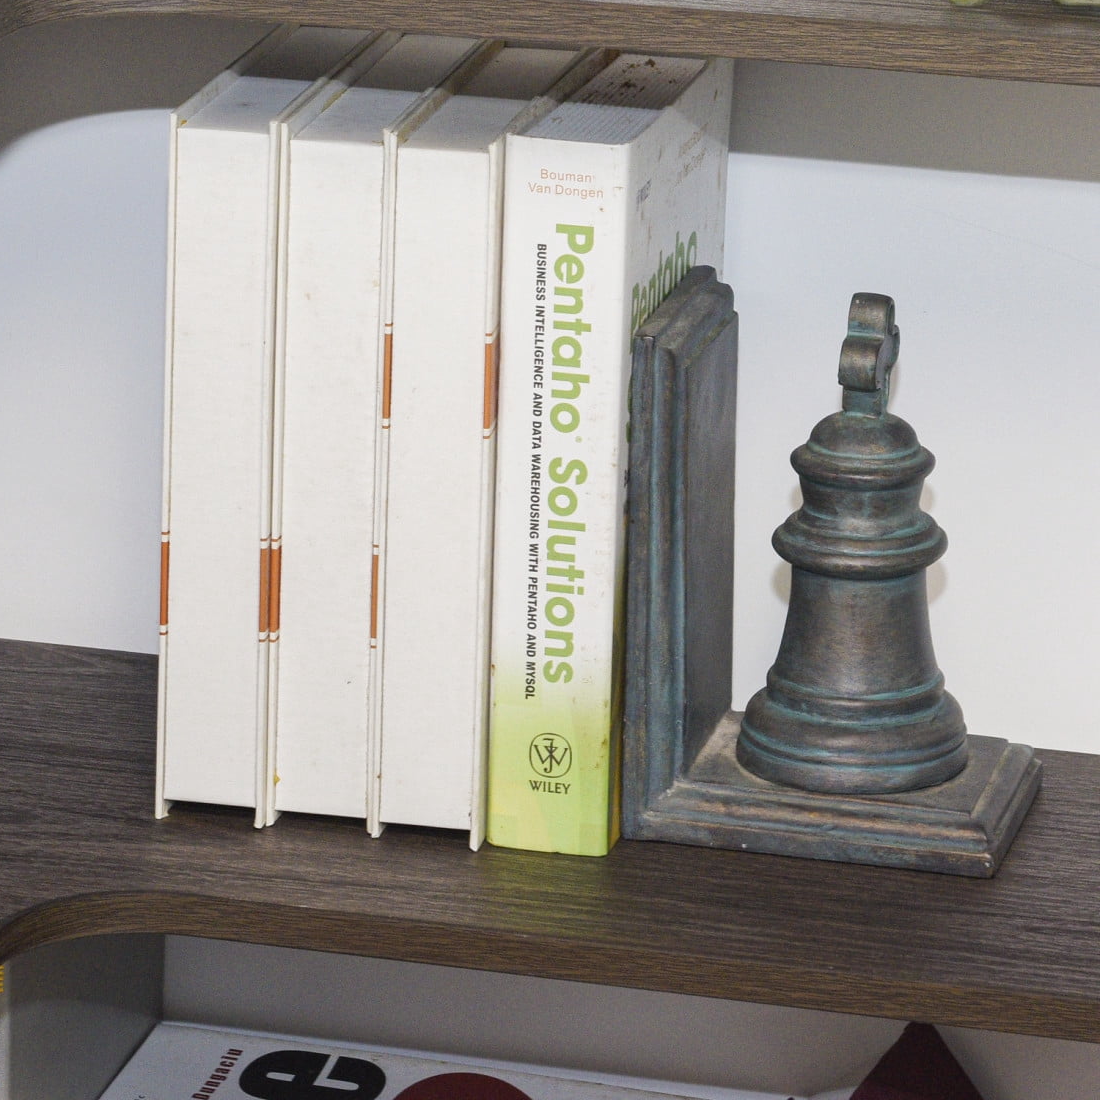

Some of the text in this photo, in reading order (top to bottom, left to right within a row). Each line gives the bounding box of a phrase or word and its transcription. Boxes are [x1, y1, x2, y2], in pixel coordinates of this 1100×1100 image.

[528, 182, 604, 199] Van Dongen
[540, 168, 592, 183] Bouman
[543, 224, 595, 684] Pentaho Solutions
[525, 243, 547, 700] BUSINESS INTELLIGENCE AND DATA WAREHOUSING WITH PENTAHO AND MYSQL
[529, 779, 571, 795] WILEY
[191, 1048, 244, 1100] Dungaciu
